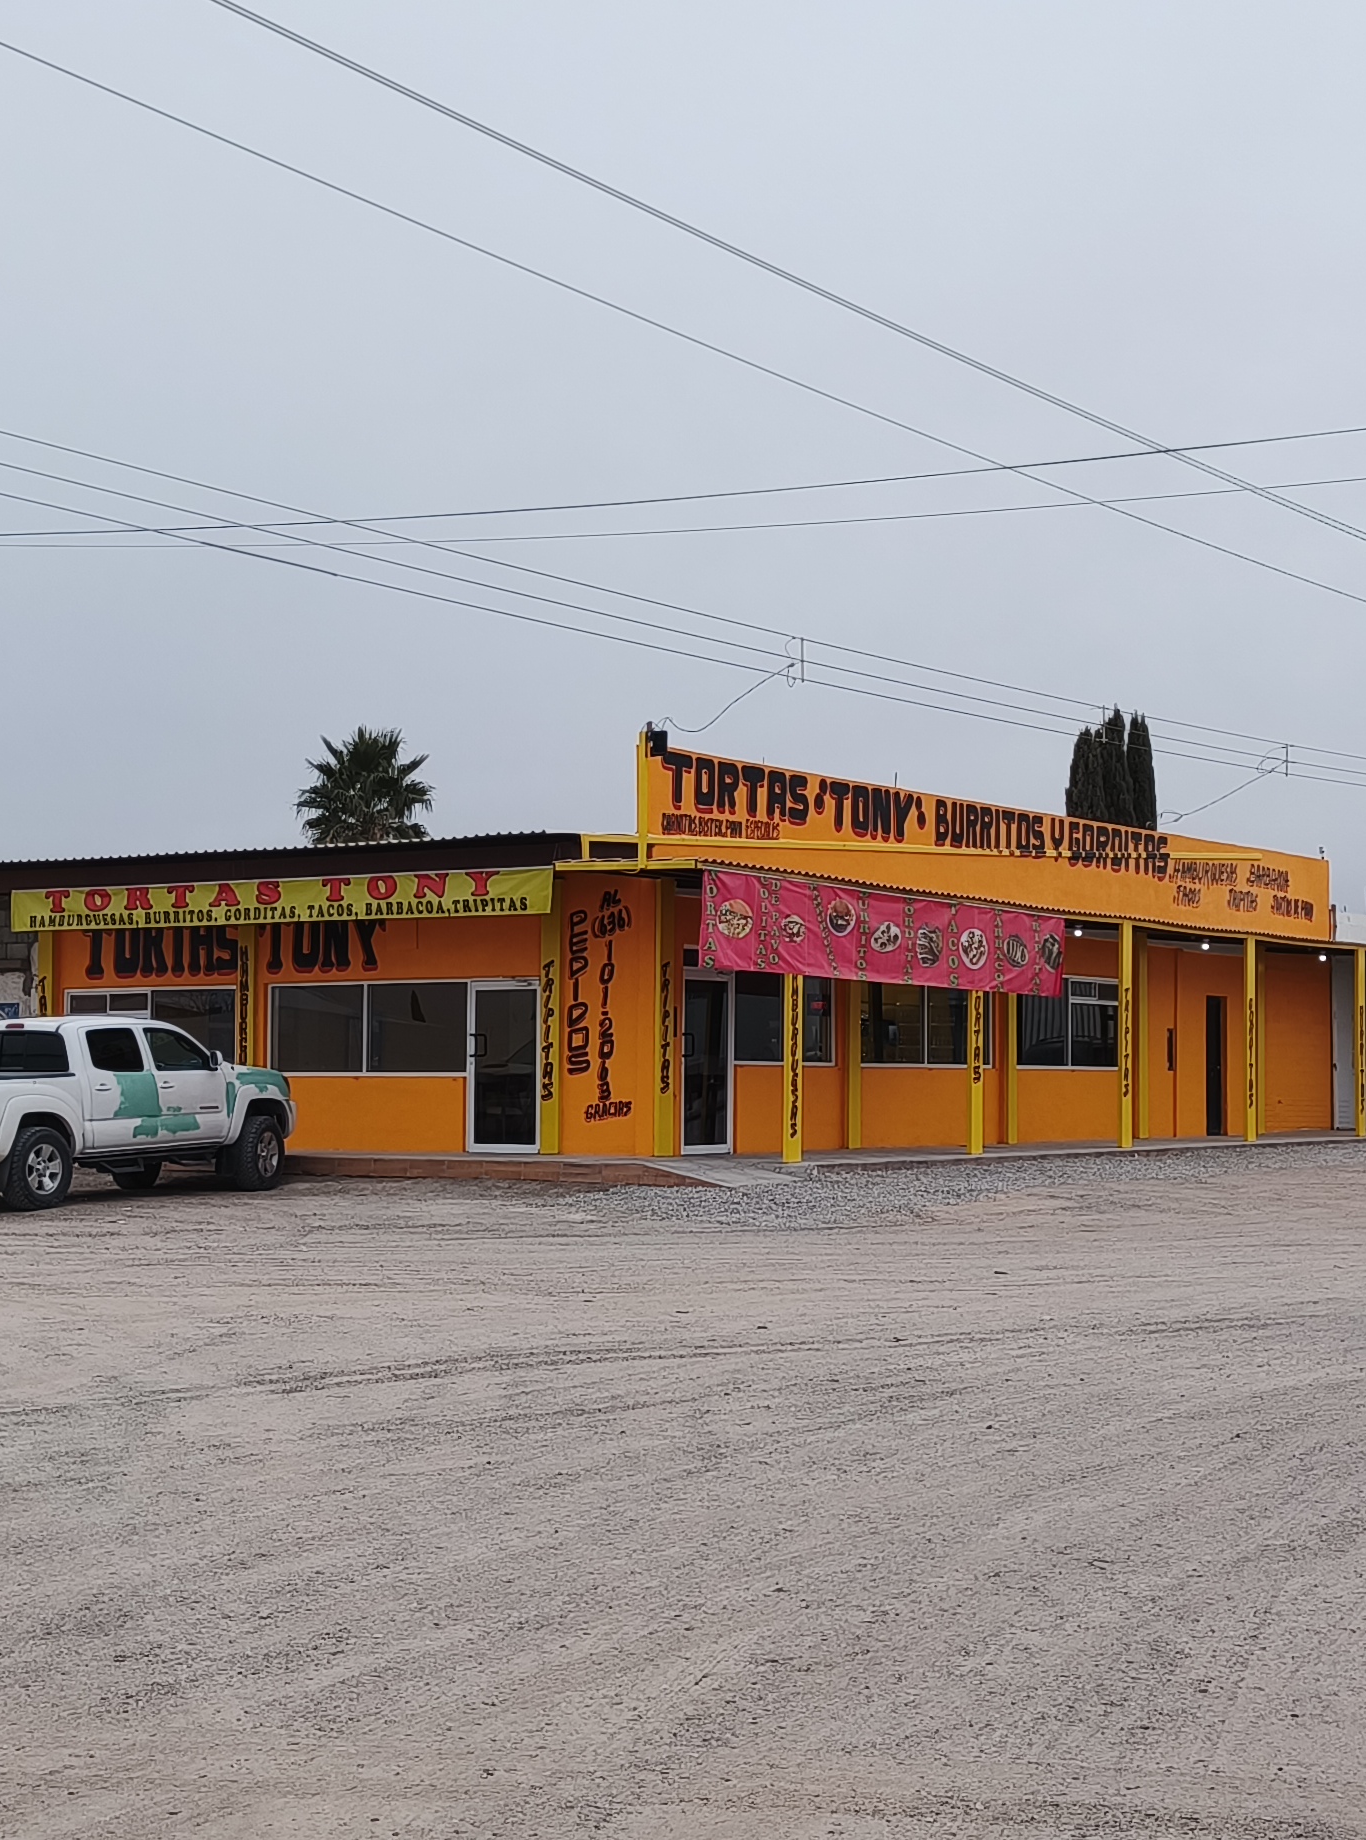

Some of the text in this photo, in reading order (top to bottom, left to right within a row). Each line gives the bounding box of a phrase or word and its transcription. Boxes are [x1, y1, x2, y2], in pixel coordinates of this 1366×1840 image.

[661, 751, 809, 826] TORTAS
[934, 799, 1047, 859] BURRITOS
[1050, 817, 1065, 862] Y
[1068, 821, 1171, 882] GORDITAS
[29, 911, 140, 929] HAMBURGUESAS,
[224, 904, 301, 922] GORDITAS,
[307, 903, 359, 919] TACOS,
[44, 871, 501, 914] TORTAS TONY
[591, 905, 632, 938] (636)
[757, 876, 770, 969] COLITAS
[769, 881, 781, 964] DE PAVO
[82, 920, 386, 980] TORTAS TONY
[541, 959, 555, 1101] TRIPITAS
[568, 909, 591, 1075] PEDIDOS
[660, 961, 671, 1094] TRIPITAS
[584, 1101, 633, 1123] GRACIAS
